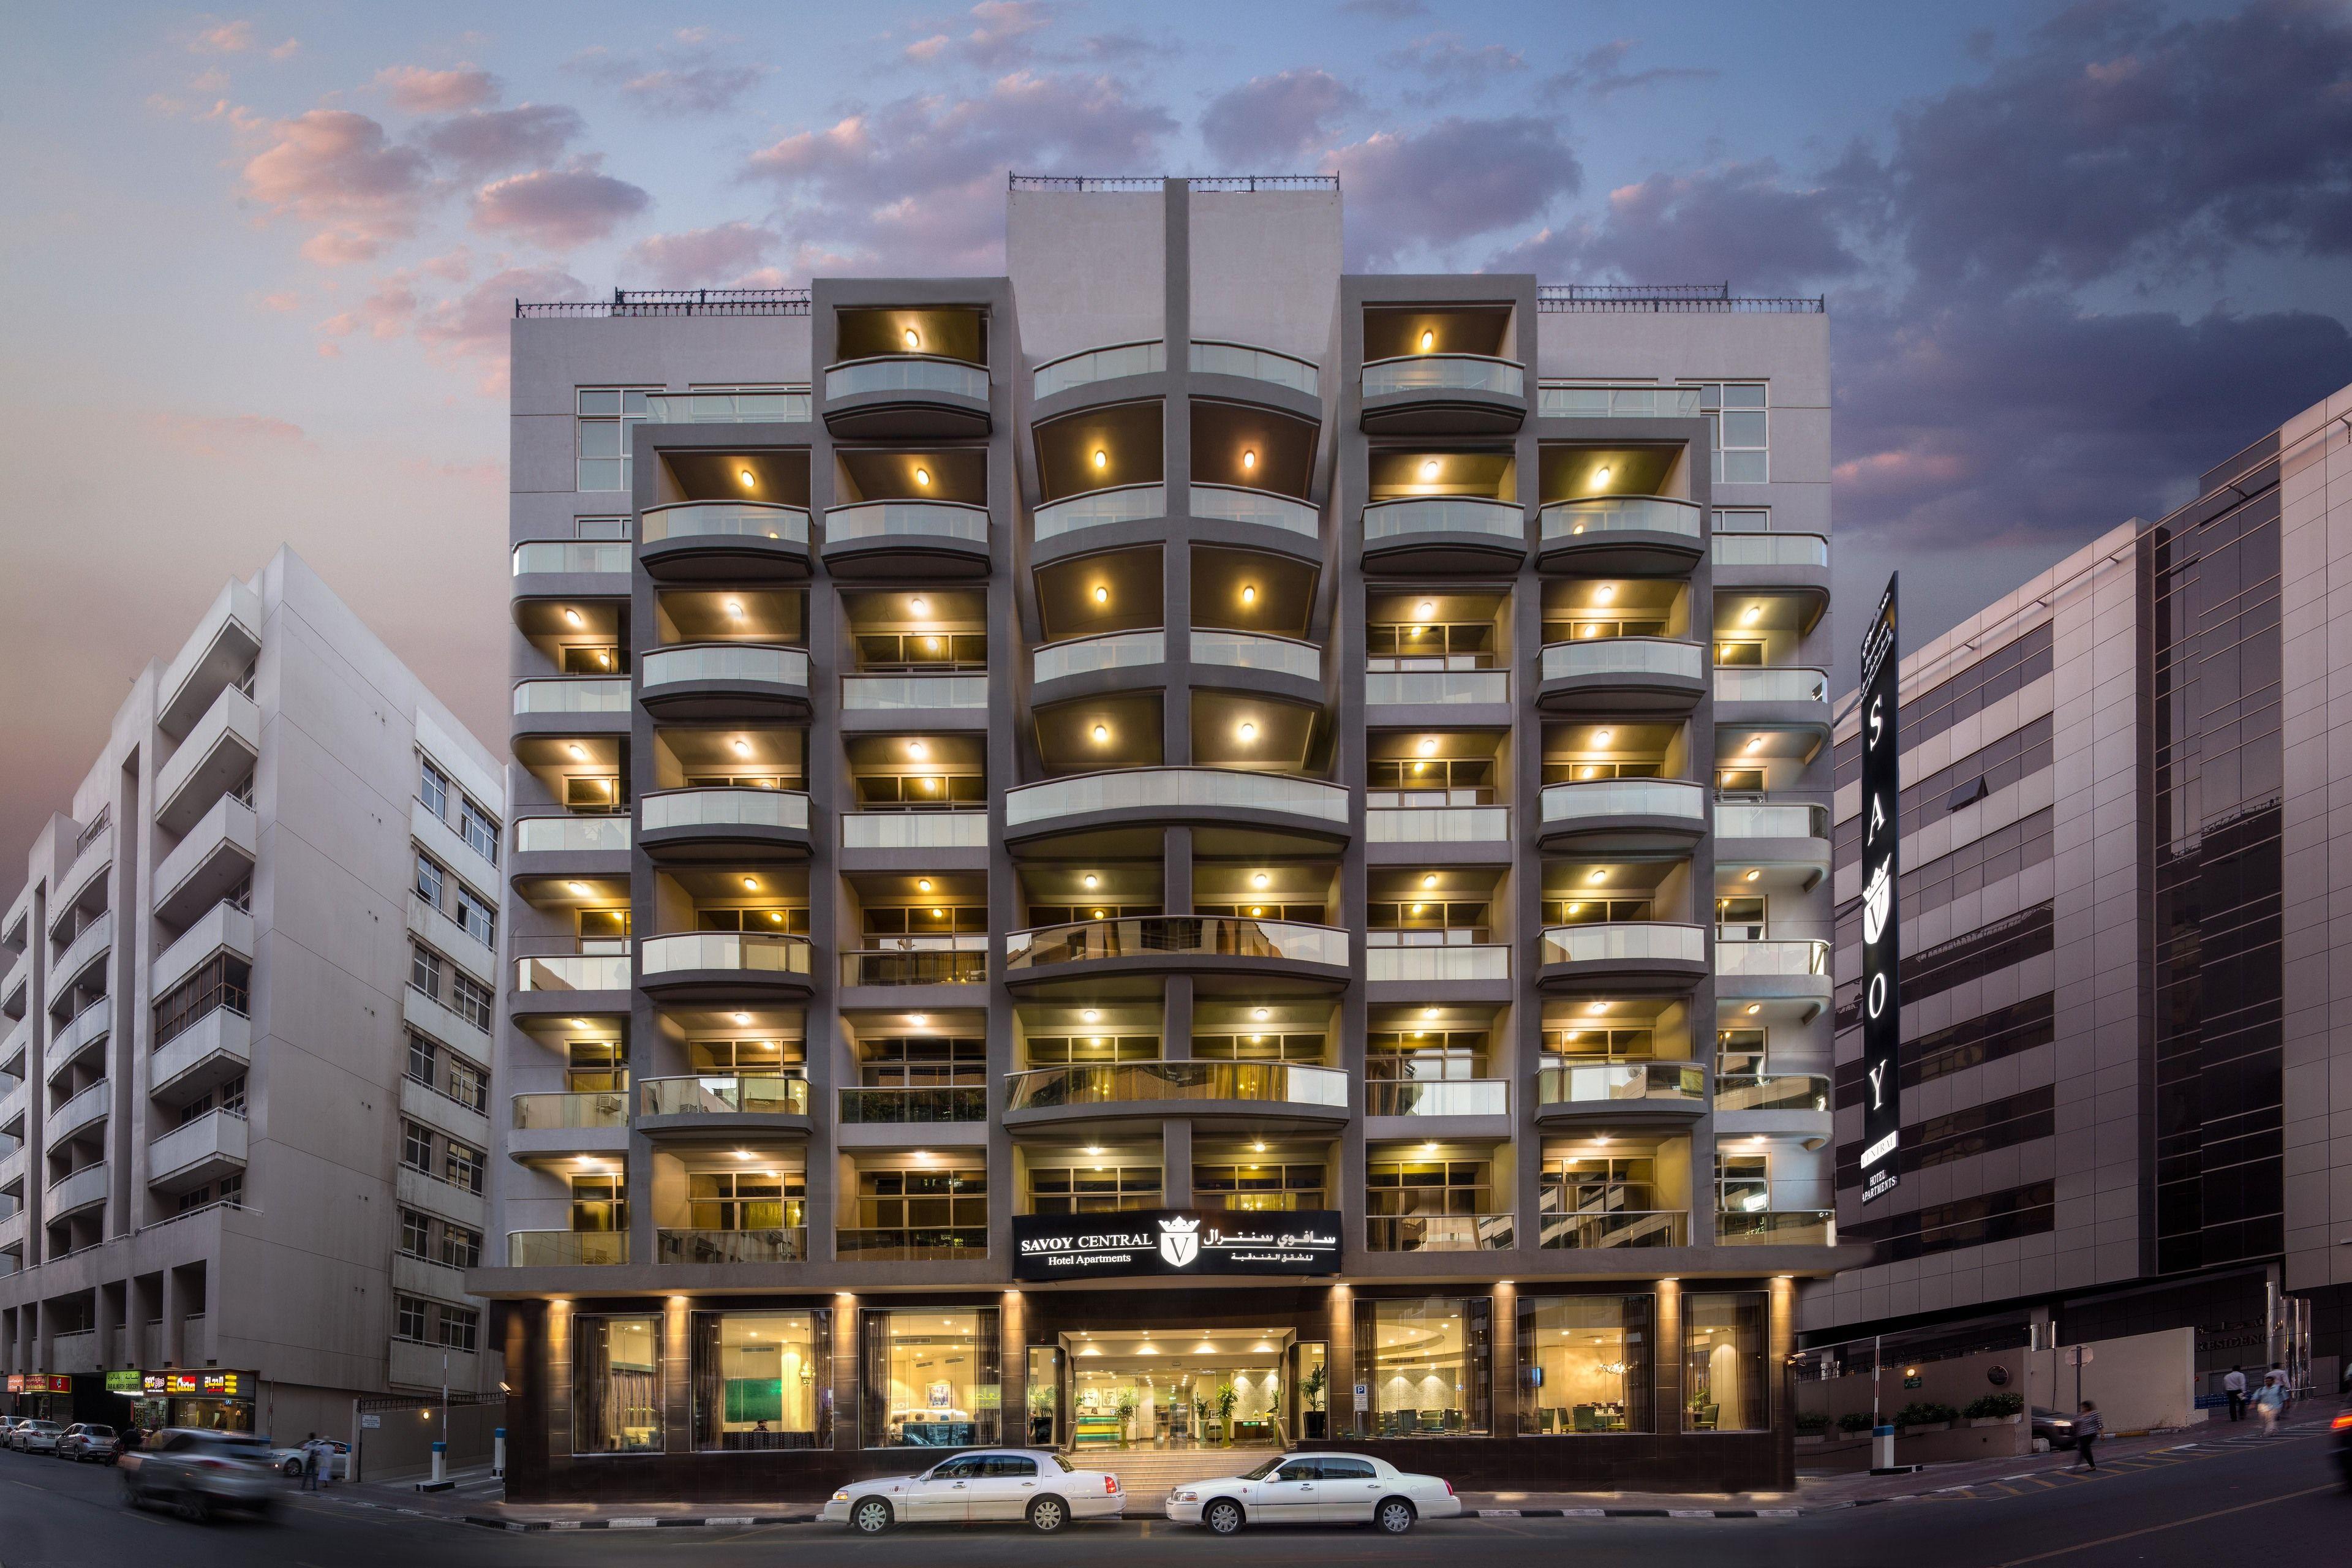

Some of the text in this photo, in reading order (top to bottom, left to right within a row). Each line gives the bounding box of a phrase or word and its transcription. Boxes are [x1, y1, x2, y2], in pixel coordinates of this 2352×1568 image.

[1870, 1169, 1887, 1187] HOTEL
[1861, 1175, 1896, 1202] APARTMENTS
[1021, 1233, 1153, 1252] SAVOY CENTRAL
[1204, 1228, 1336, 1248] سافوي سنترال
[1048, 1254, 1131, 1266] Hotel Apartments
[1231, 1253, 1281, 1262] الفندقية
[177, 1377, 195, 1392] Chicken
[205, 1376, 224, 1387] الدجاج
